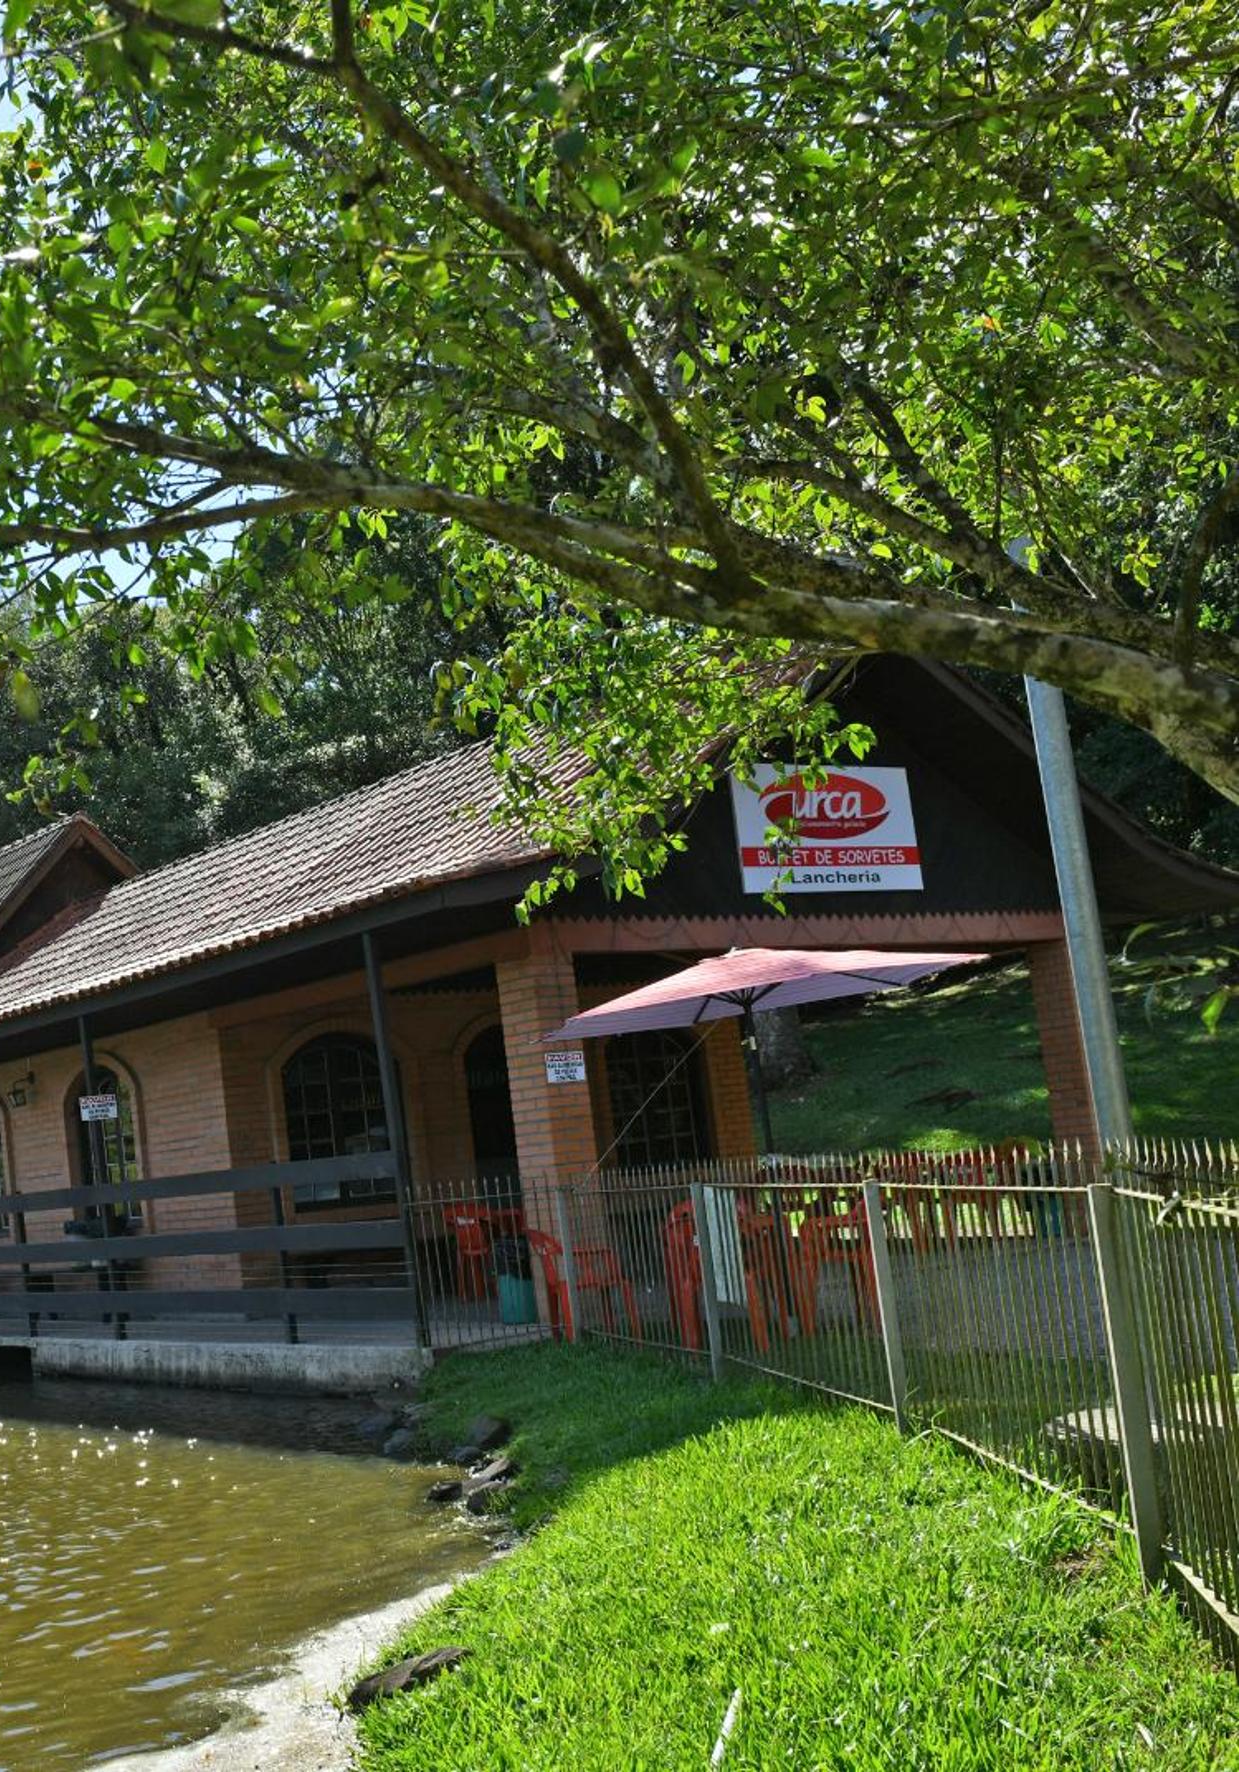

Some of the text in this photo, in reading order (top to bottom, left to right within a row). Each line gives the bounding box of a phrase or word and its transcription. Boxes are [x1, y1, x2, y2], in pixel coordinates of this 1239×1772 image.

[815, 850, 835, 865] DE
[838, 849, 905, 864] SORVETES
[791, 870, 881, 884] Lancheria
